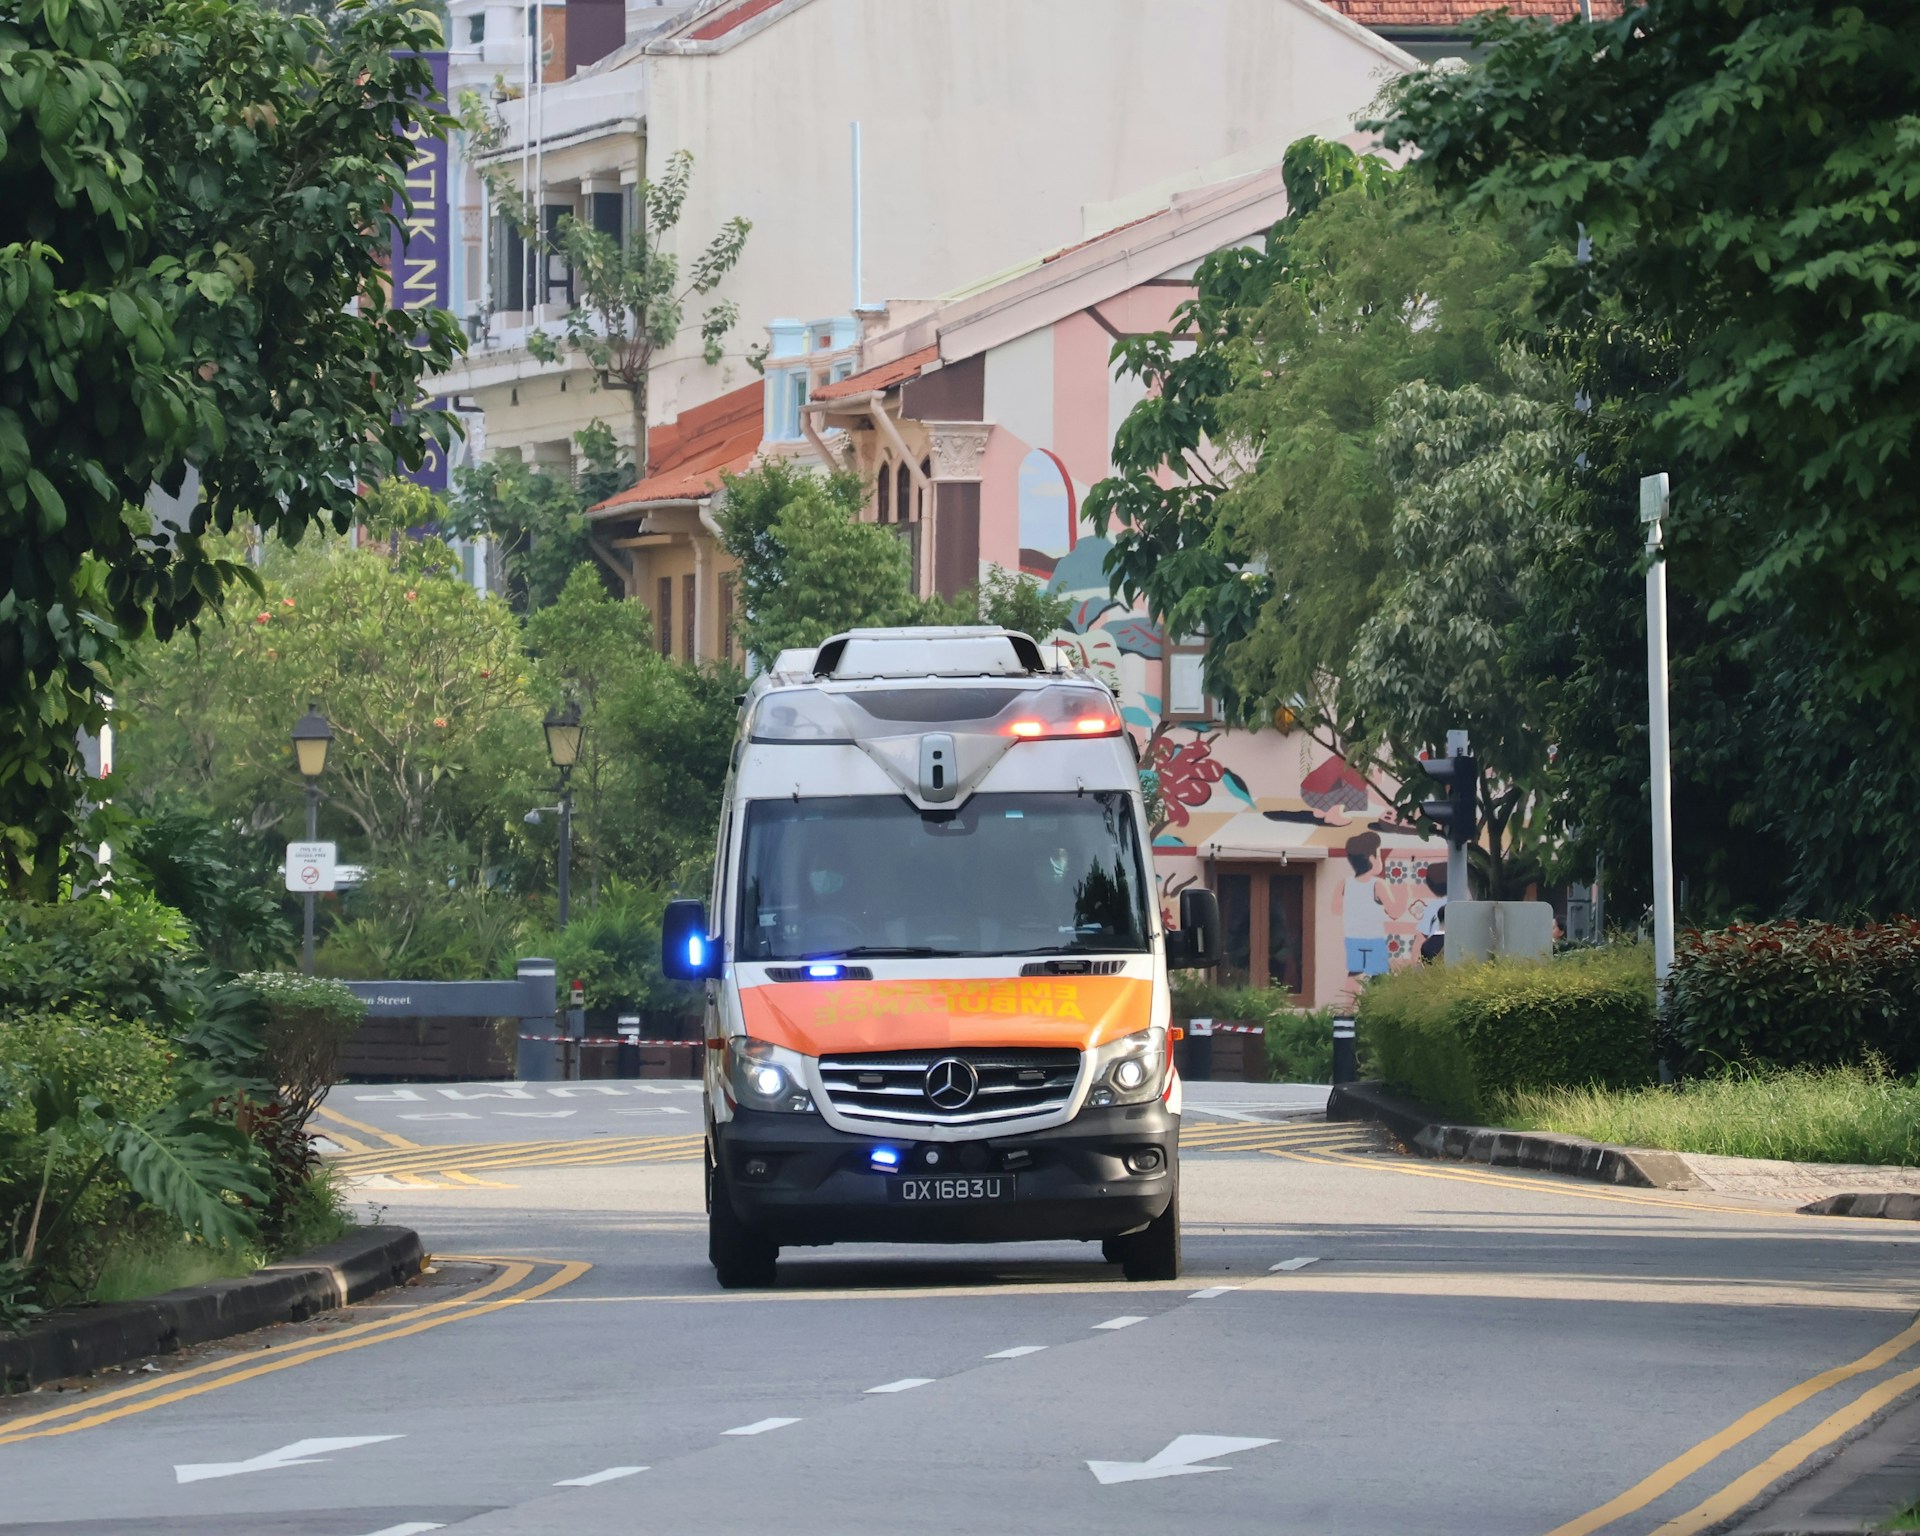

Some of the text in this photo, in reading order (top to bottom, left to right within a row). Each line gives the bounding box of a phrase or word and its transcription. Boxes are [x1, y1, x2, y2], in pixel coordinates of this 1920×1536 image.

[402, 114, 437, 244] BATIK
[377, 995, 411, 1005] Street
[903, 1180, 1000, 1200] QX1683U
